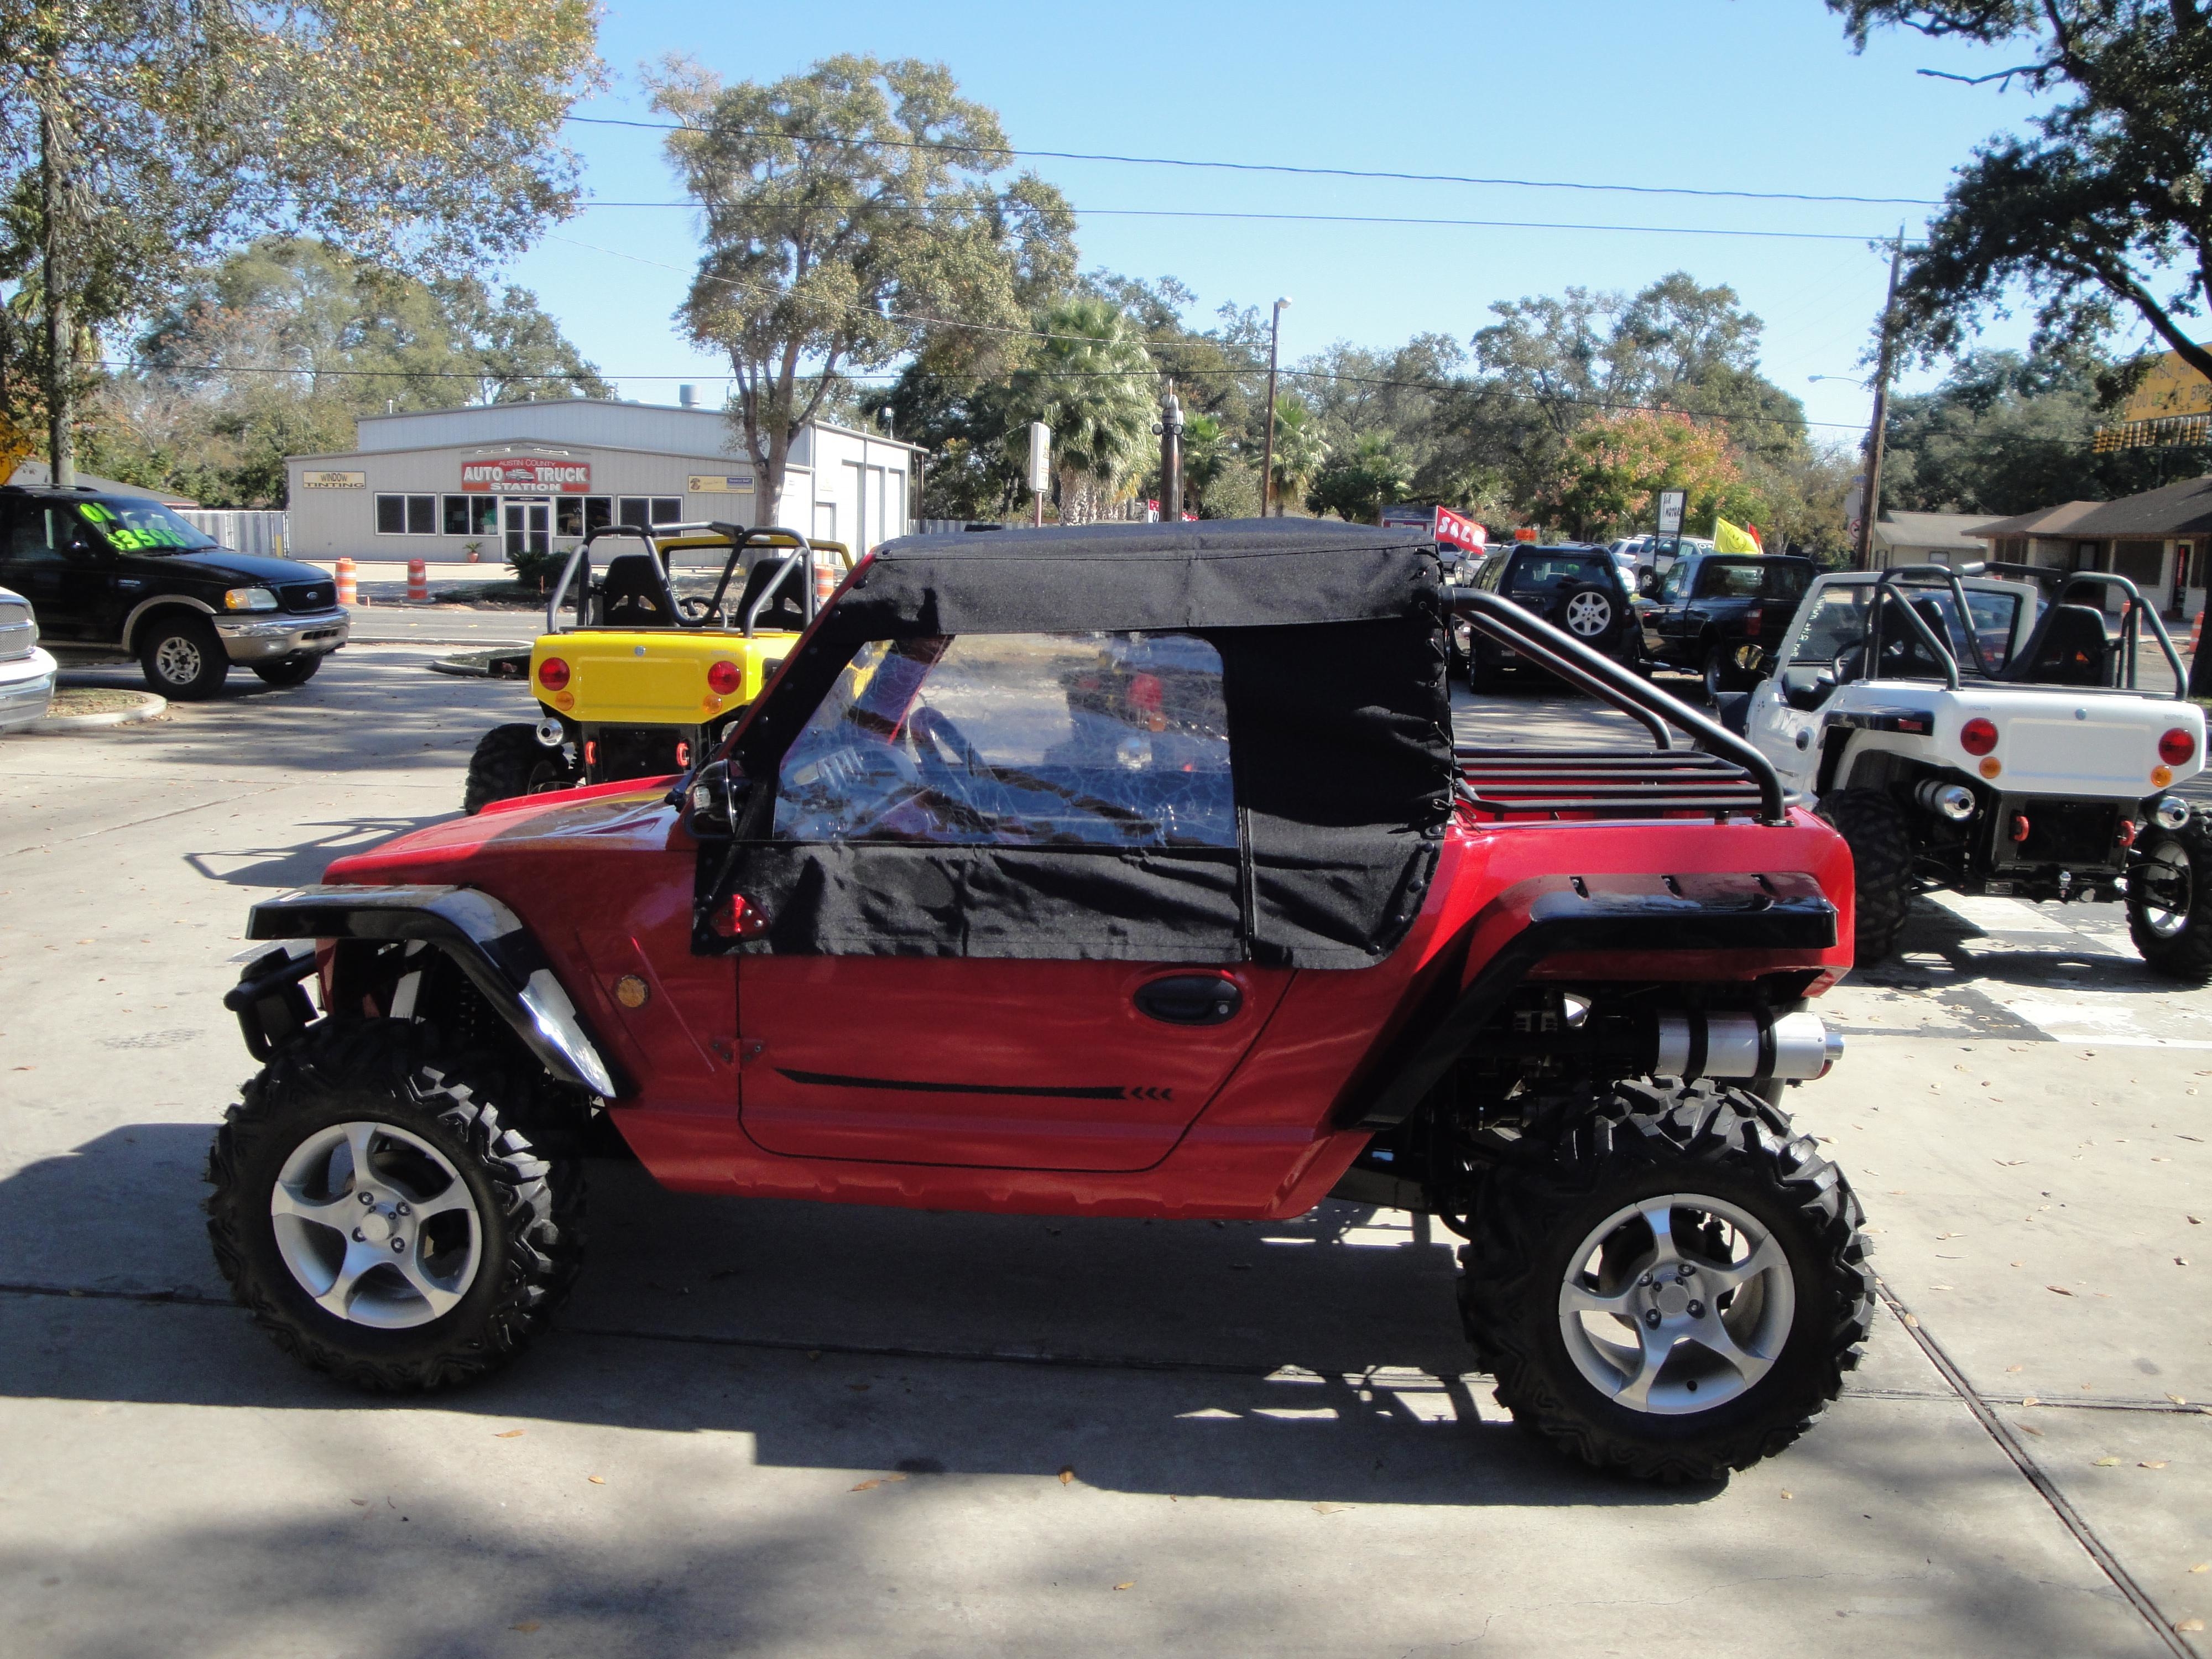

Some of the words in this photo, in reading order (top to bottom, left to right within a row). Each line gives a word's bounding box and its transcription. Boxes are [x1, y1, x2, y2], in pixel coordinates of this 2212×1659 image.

[320, 472, 347, 482] WINDOW
[463, 466, 504, 482] AUTO
[535, 467, 587, 482] TRUCK
[490, 483, 561, 491] STATION
[80, 502, 117, 523] 01
[106, 529, 186, 550] $3598
